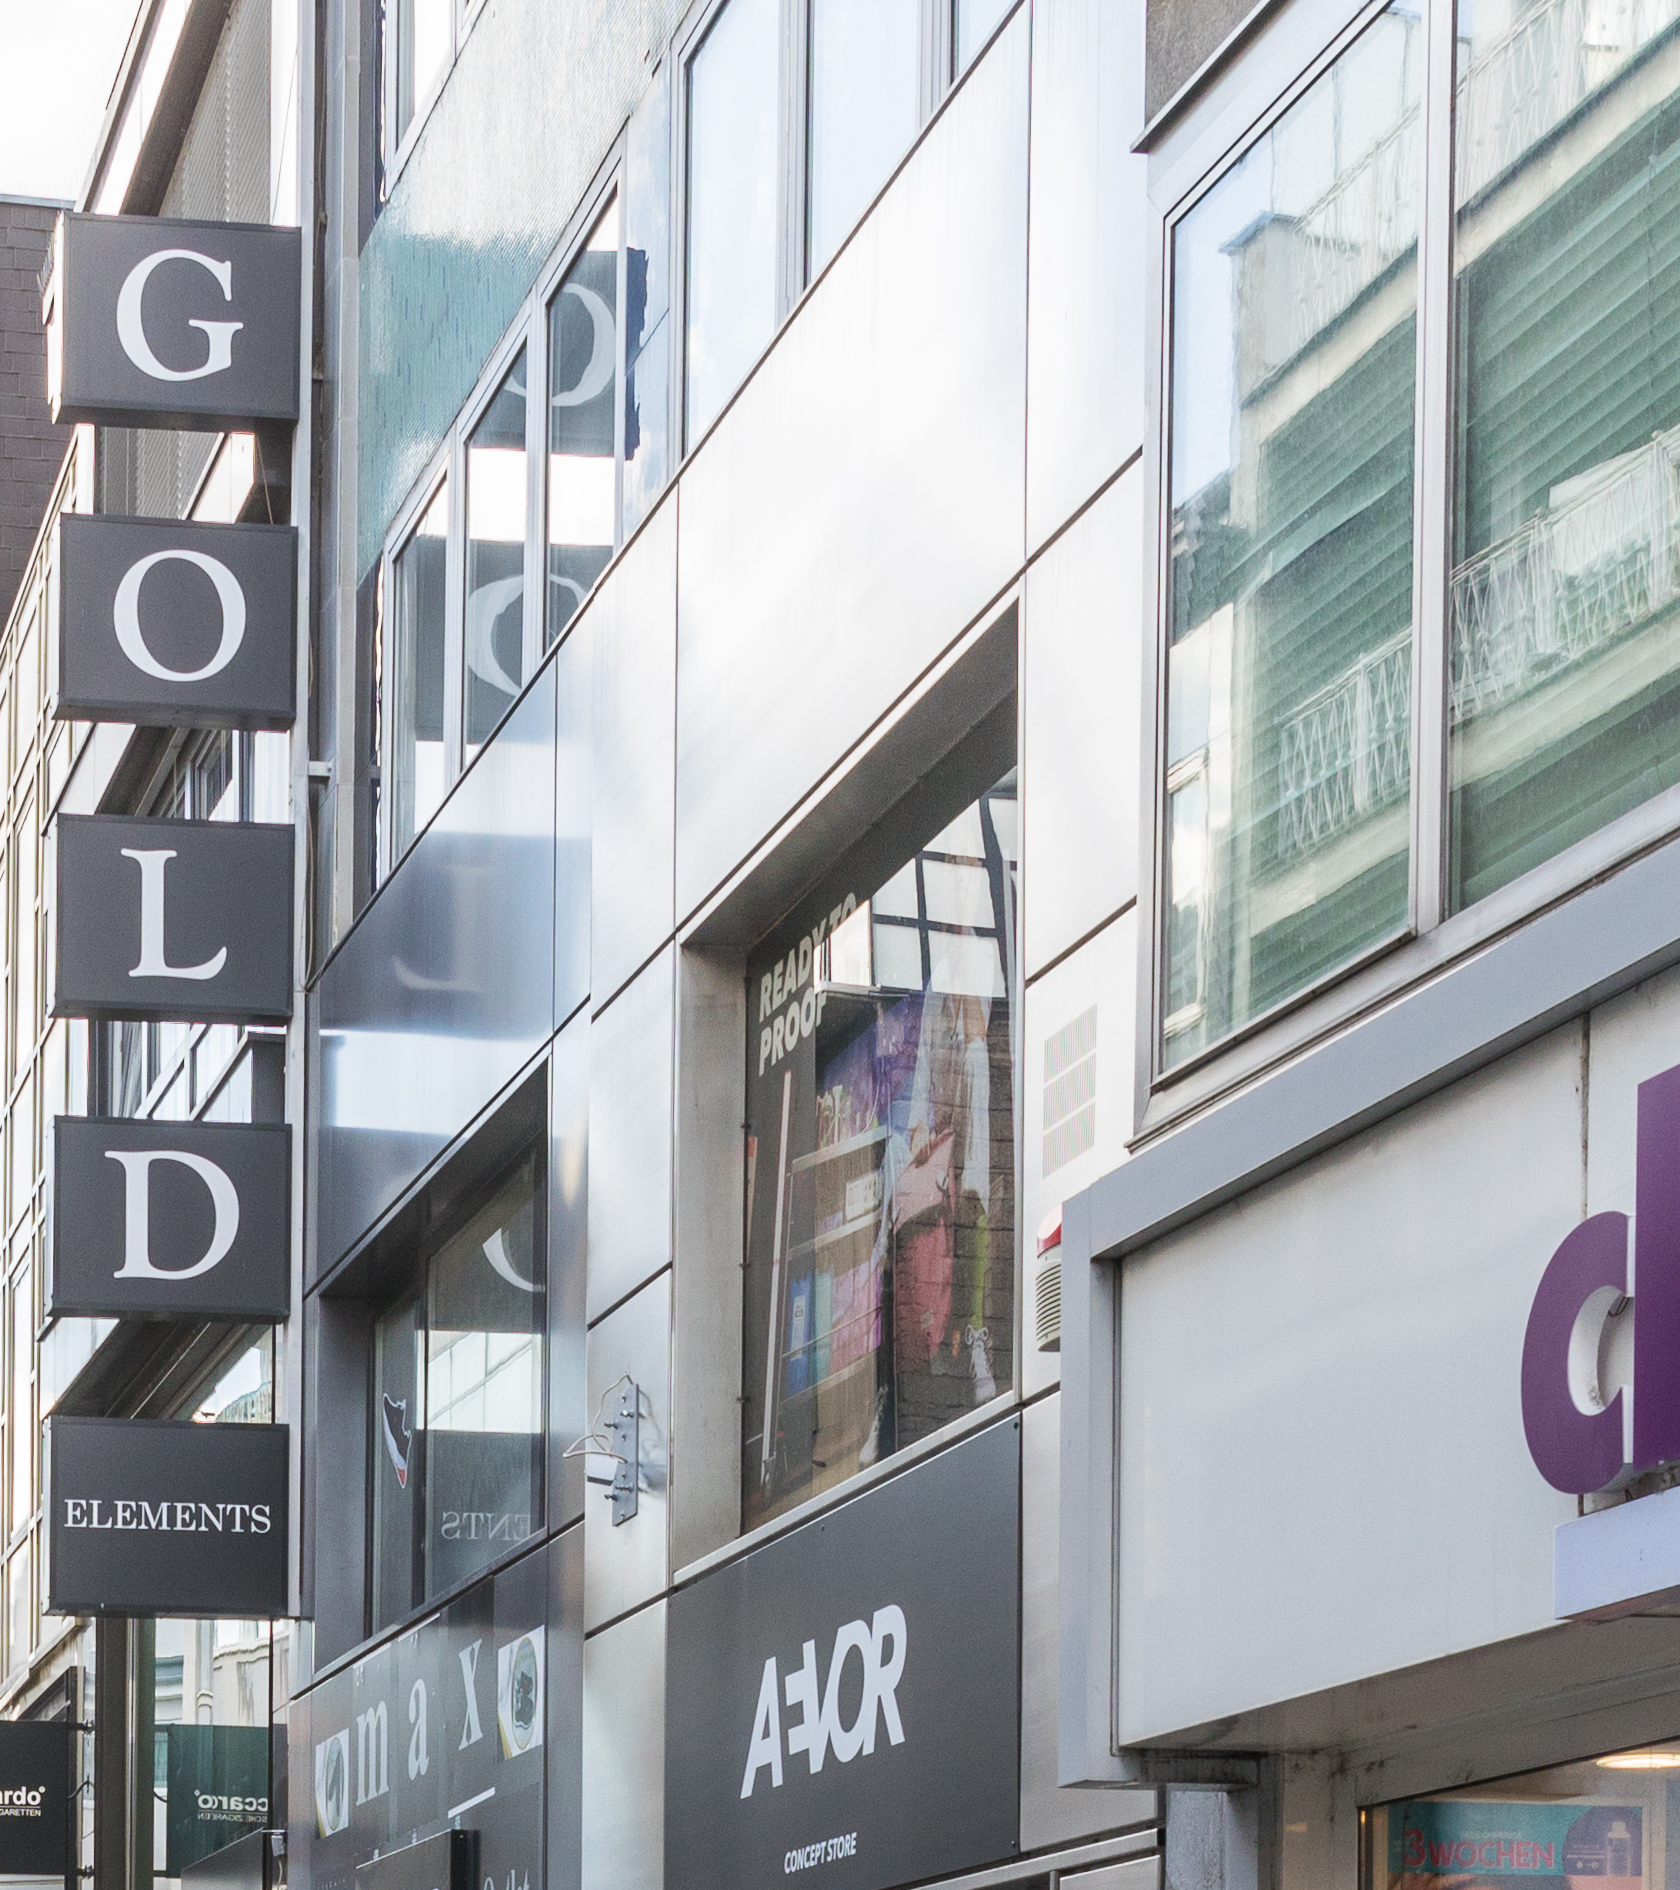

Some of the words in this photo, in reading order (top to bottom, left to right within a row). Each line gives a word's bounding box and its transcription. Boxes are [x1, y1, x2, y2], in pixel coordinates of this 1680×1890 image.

[758, 987, 827, 1077] PROOF
[63, 1500, 273, 1535] ELEMENTS
[783, 1838, 826, 1875] CONCEPT
[826, 1832, 858, 1867] STORE
[1403, 1827, 1426, 1867] 3
[1428, 1840, 1554, 1869] WOCHEN
